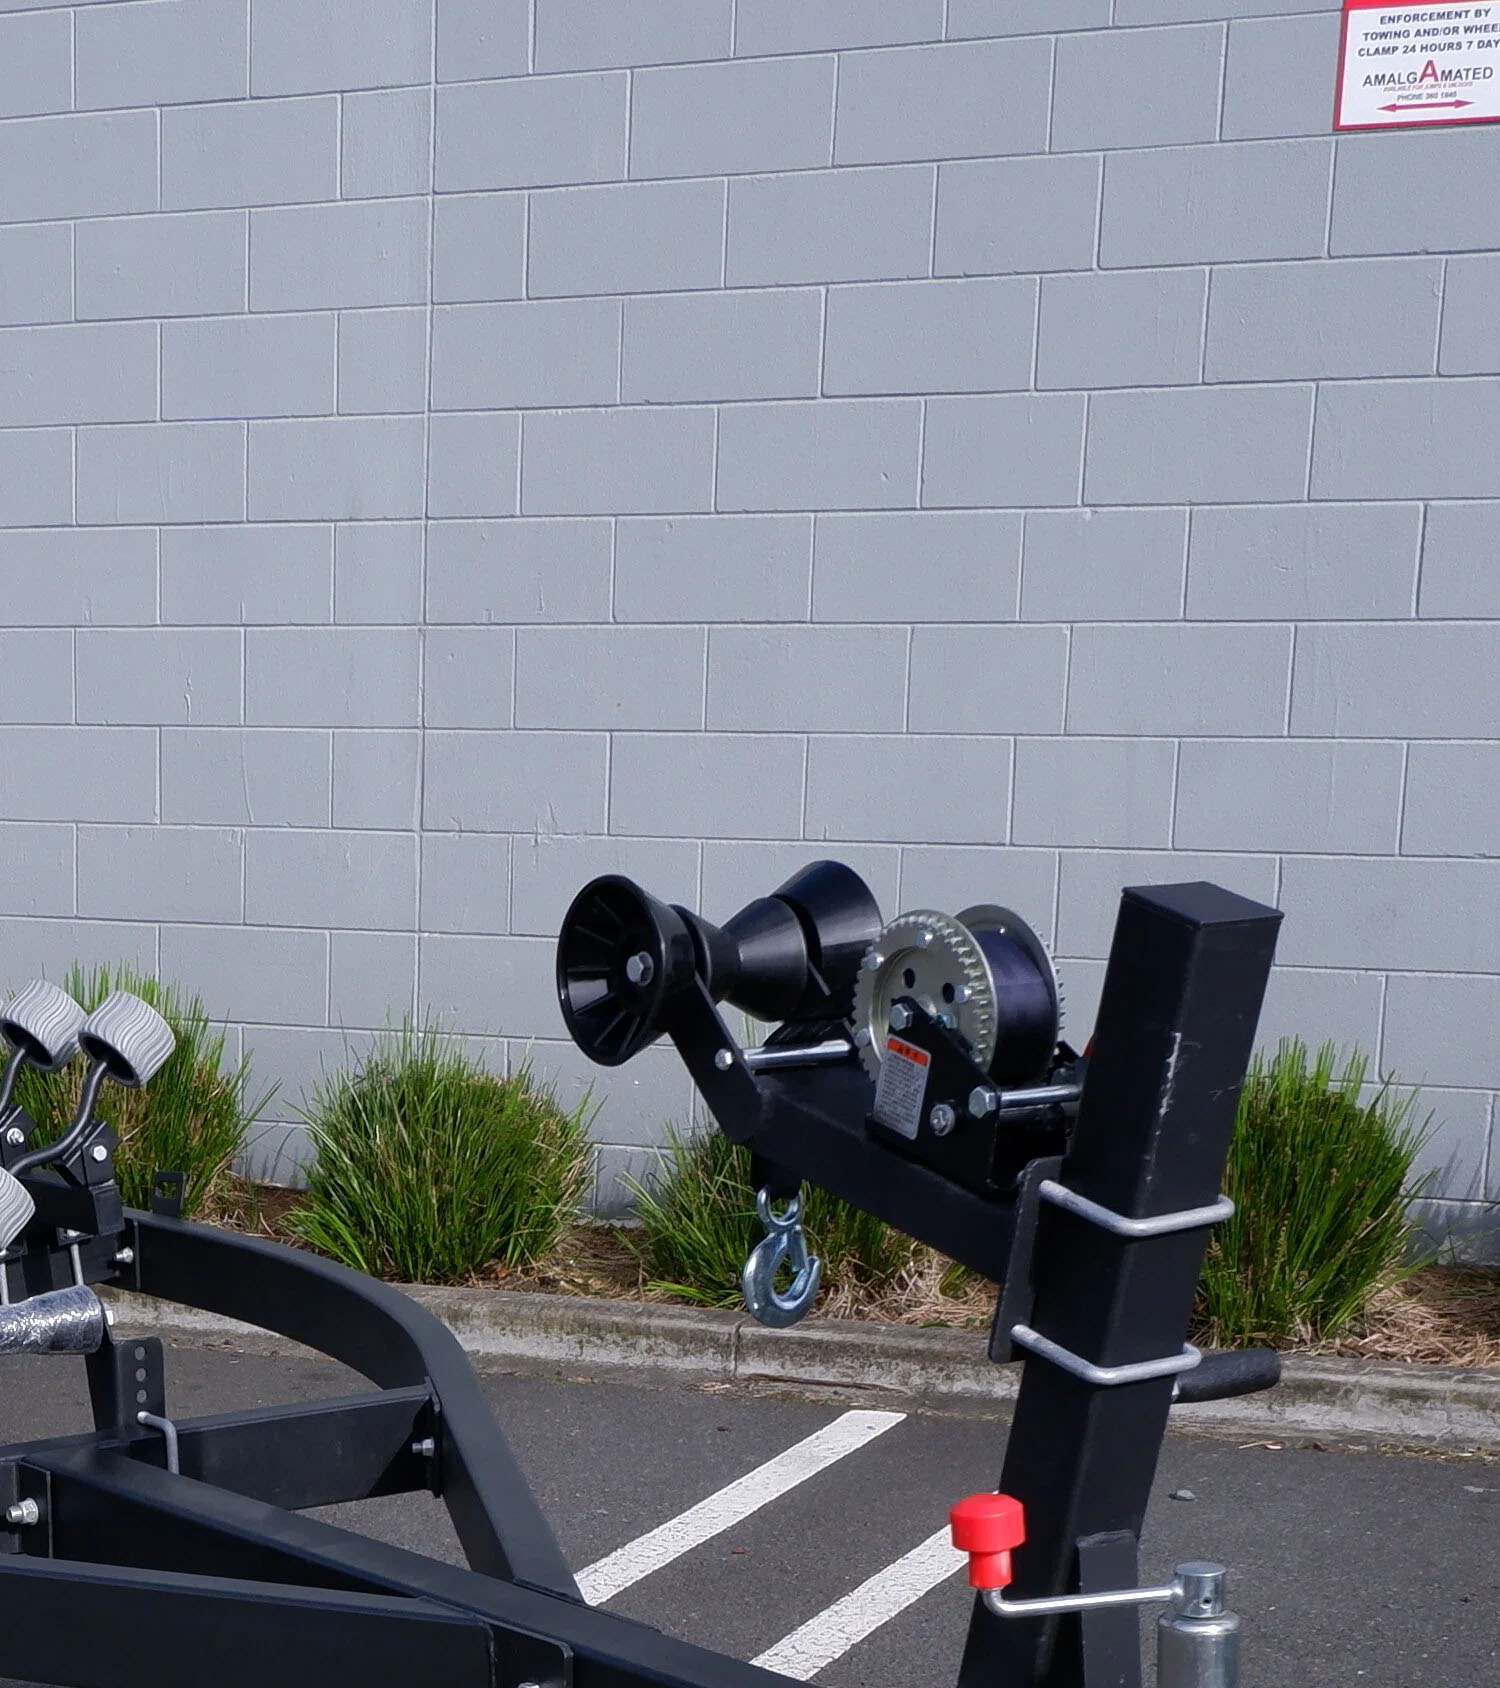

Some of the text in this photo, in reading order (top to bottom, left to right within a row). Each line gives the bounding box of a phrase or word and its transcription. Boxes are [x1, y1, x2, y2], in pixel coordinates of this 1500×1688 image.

[1379, 8, 1491, 25] ENFORCEMENT BY
[1362, 29, 1411, 42] TOWING
[1414, 25, 1460, 38] AND/OR
[1358, 47, 1399, 57] CLAMP
[1402, 44, 1416, 54] 24
[1420, 41, 1462, 53] HOURS
[1466, 41, 1474, 49] 7
[1362, 59, 1494, 87] AMALGAMATED
